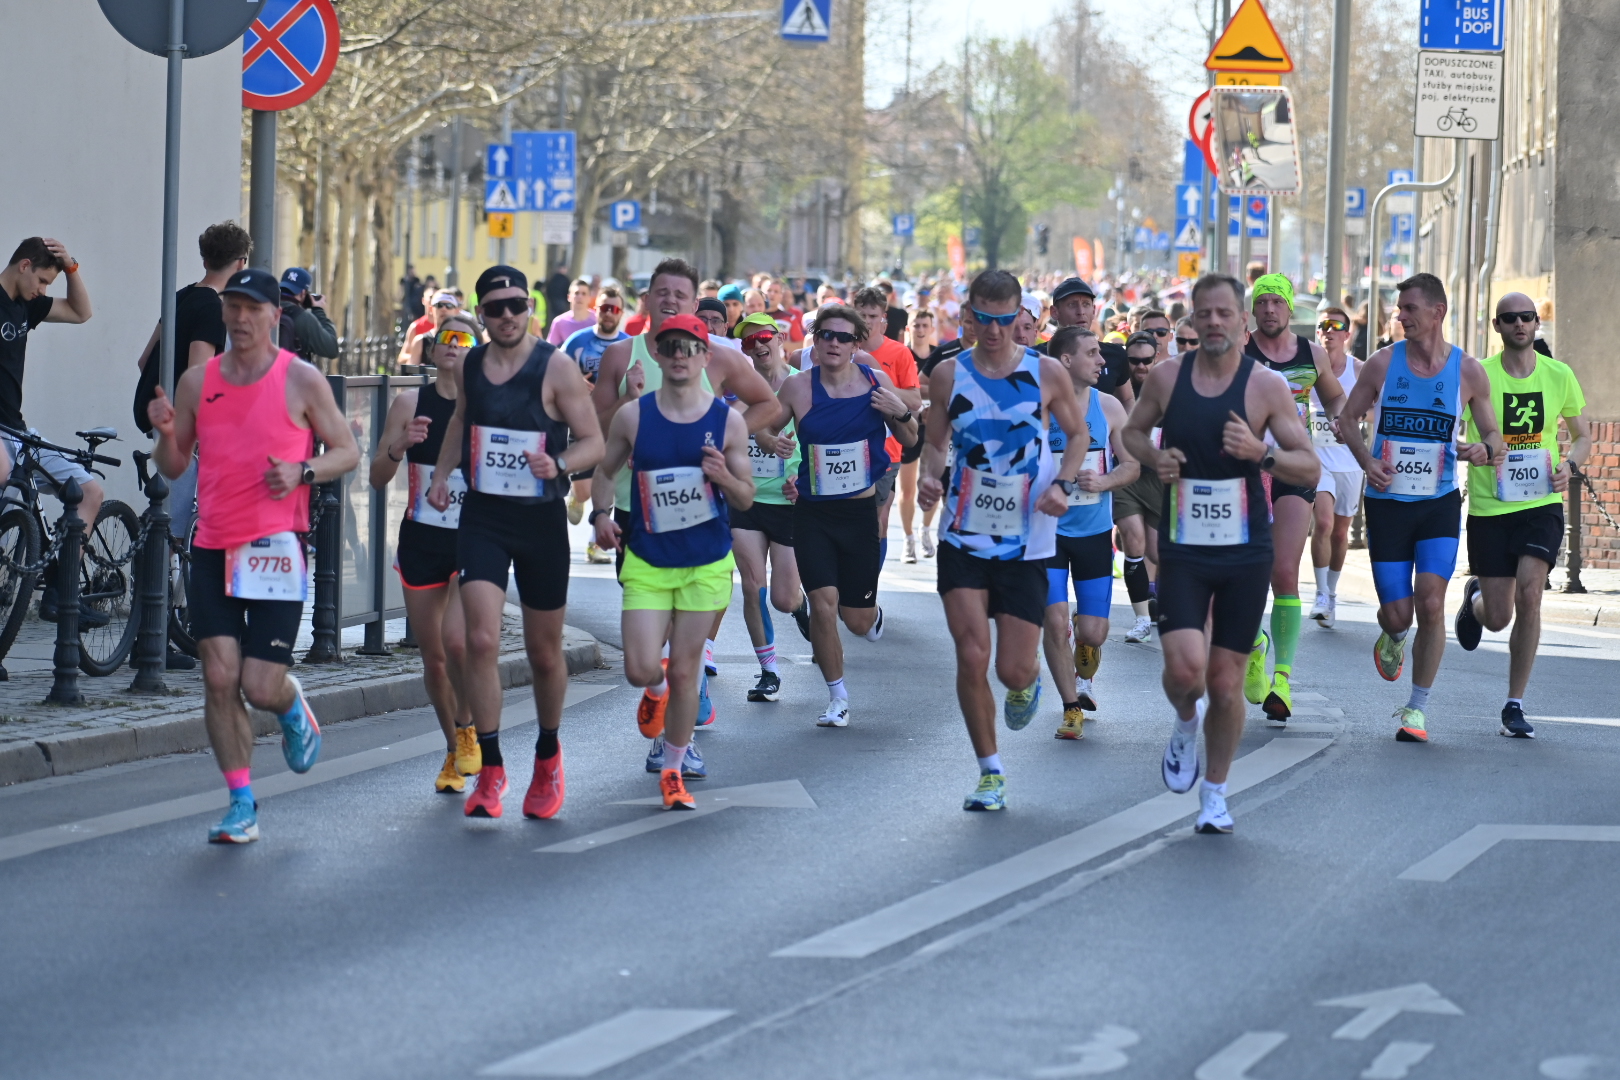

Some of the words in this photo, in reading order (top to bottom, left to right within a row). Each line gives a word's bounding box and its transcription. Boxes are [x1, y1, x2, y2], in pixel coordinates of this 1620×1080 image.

[1463, 7, 1489, 20] BUS
[1463, 21, 1492, 34] DOP
[1424, 57, 1497, 69] DOPUSZCZONE:
[1443, 93, 1496, 104] elektryczne
[616, 203, 635, 228] P
[1386, 414, 1448, 432] BEROTU
[1511, 434, 1536, 443] night
[485, 451, 528, 470] 5329
[826, 460, 856, 475] 7621
[1395, 460, 1433, 475] 6654
[1508, 467, 1539, 481] 7610
[652, 487, 702, 508] 11564
[975, 493, 1016, 512] 6906
[1191, 503, 1231, 519] 5155
[248, 556, 292, 573] 9778
